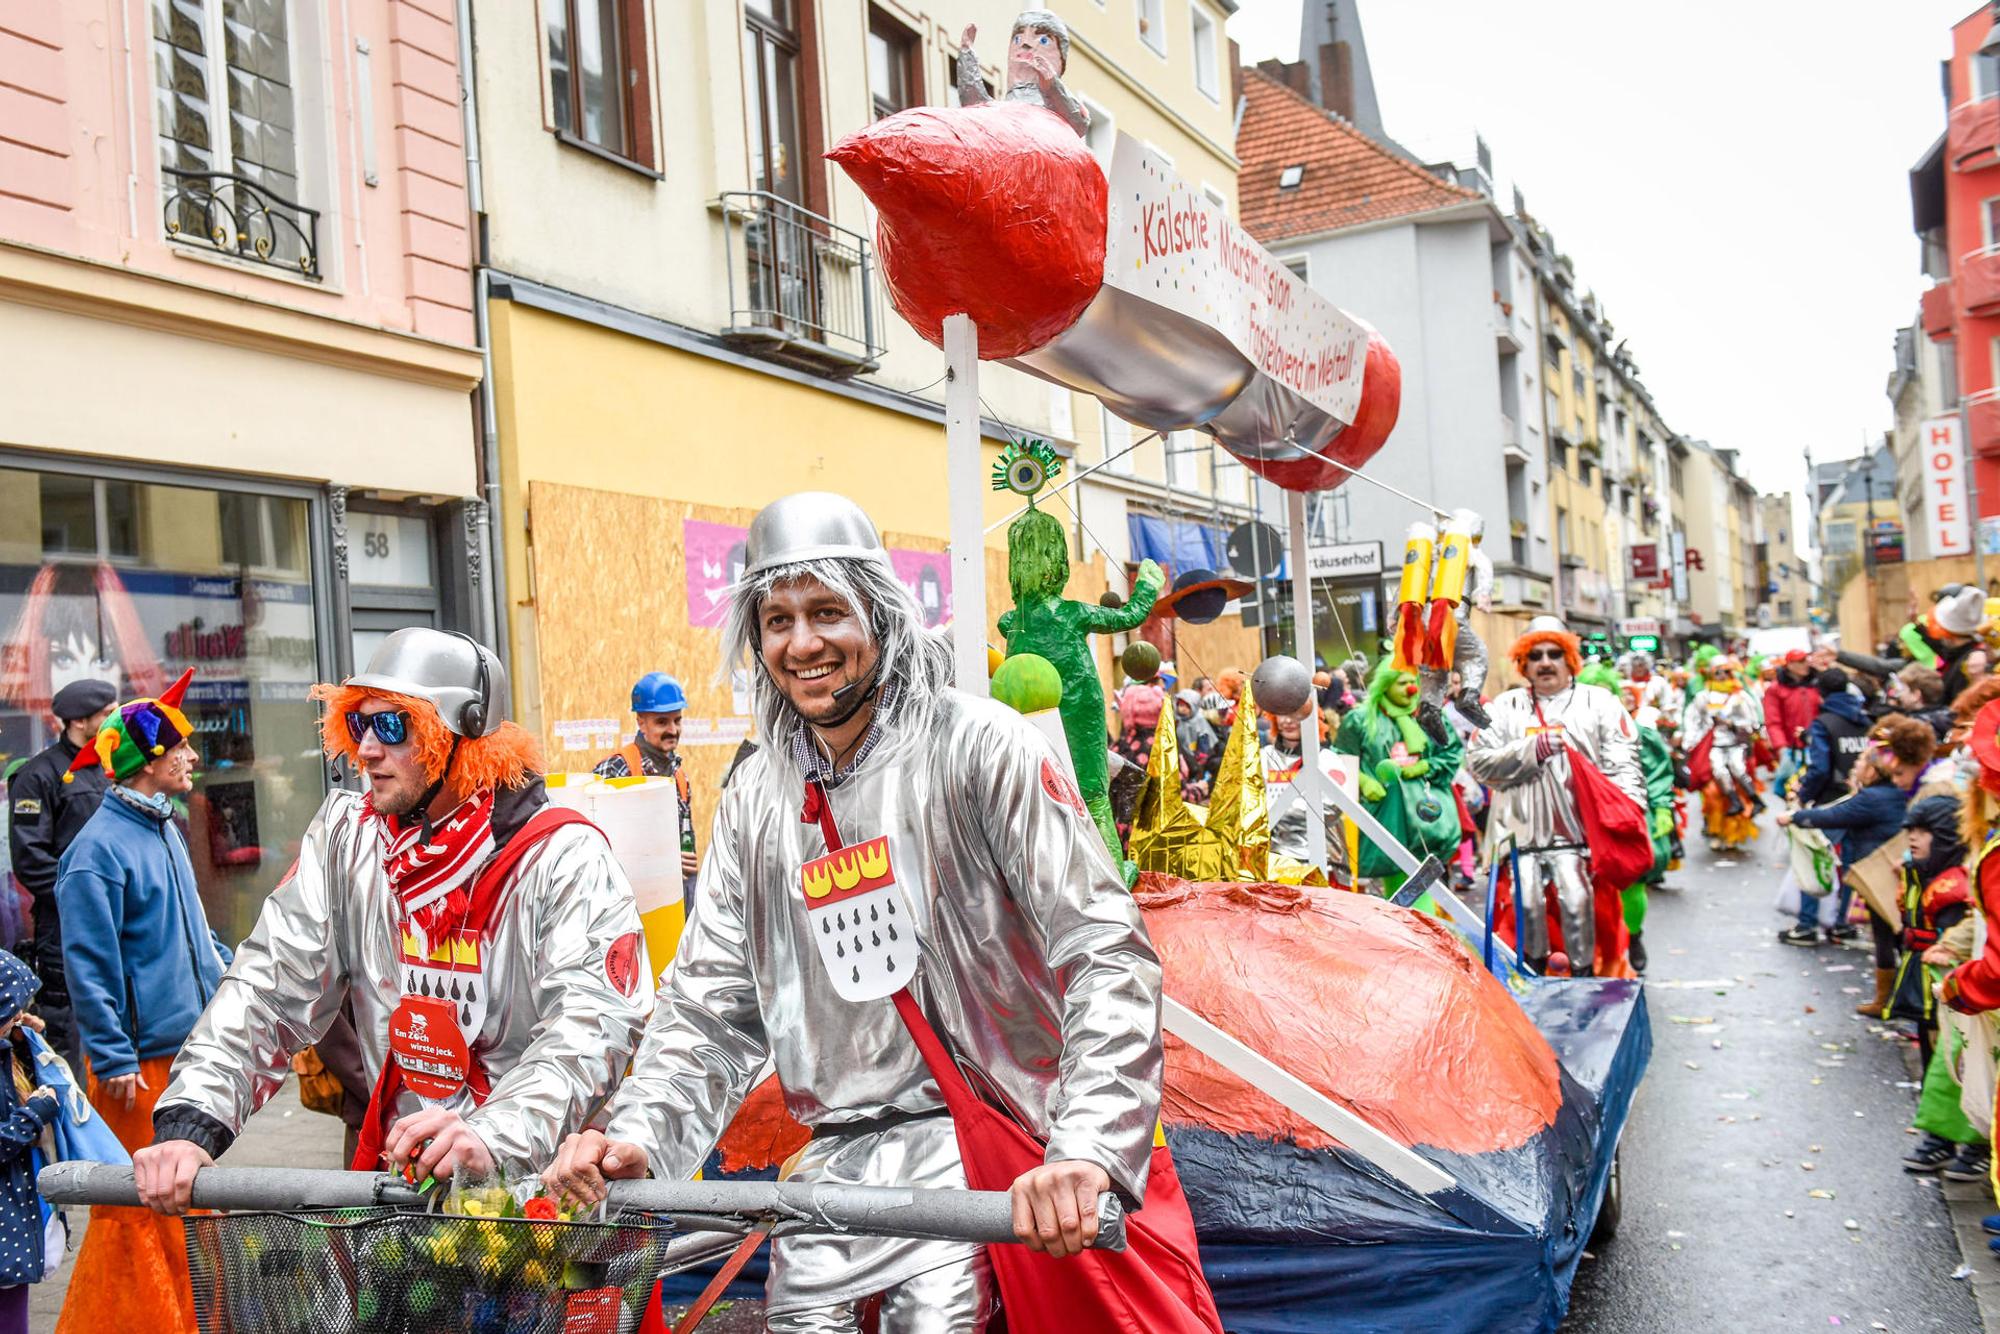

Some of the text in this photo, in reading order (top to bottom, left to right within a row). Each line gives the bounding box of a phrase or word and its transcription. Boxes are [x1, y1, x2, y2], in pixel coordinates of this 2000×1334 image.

[1142, 193, 1209, 264] Kölsche
[1931, 426, 1958, 548] HOTEL
[364, 532, 389, 559] 58
[1309, 550, 1375, 569] rtäuserhof
[1838, 735, 1867, 754] POLI
[394, 1028, 430, 1043] Em Zoch
[410, 1042, 456, 1058] wirste jeck.
